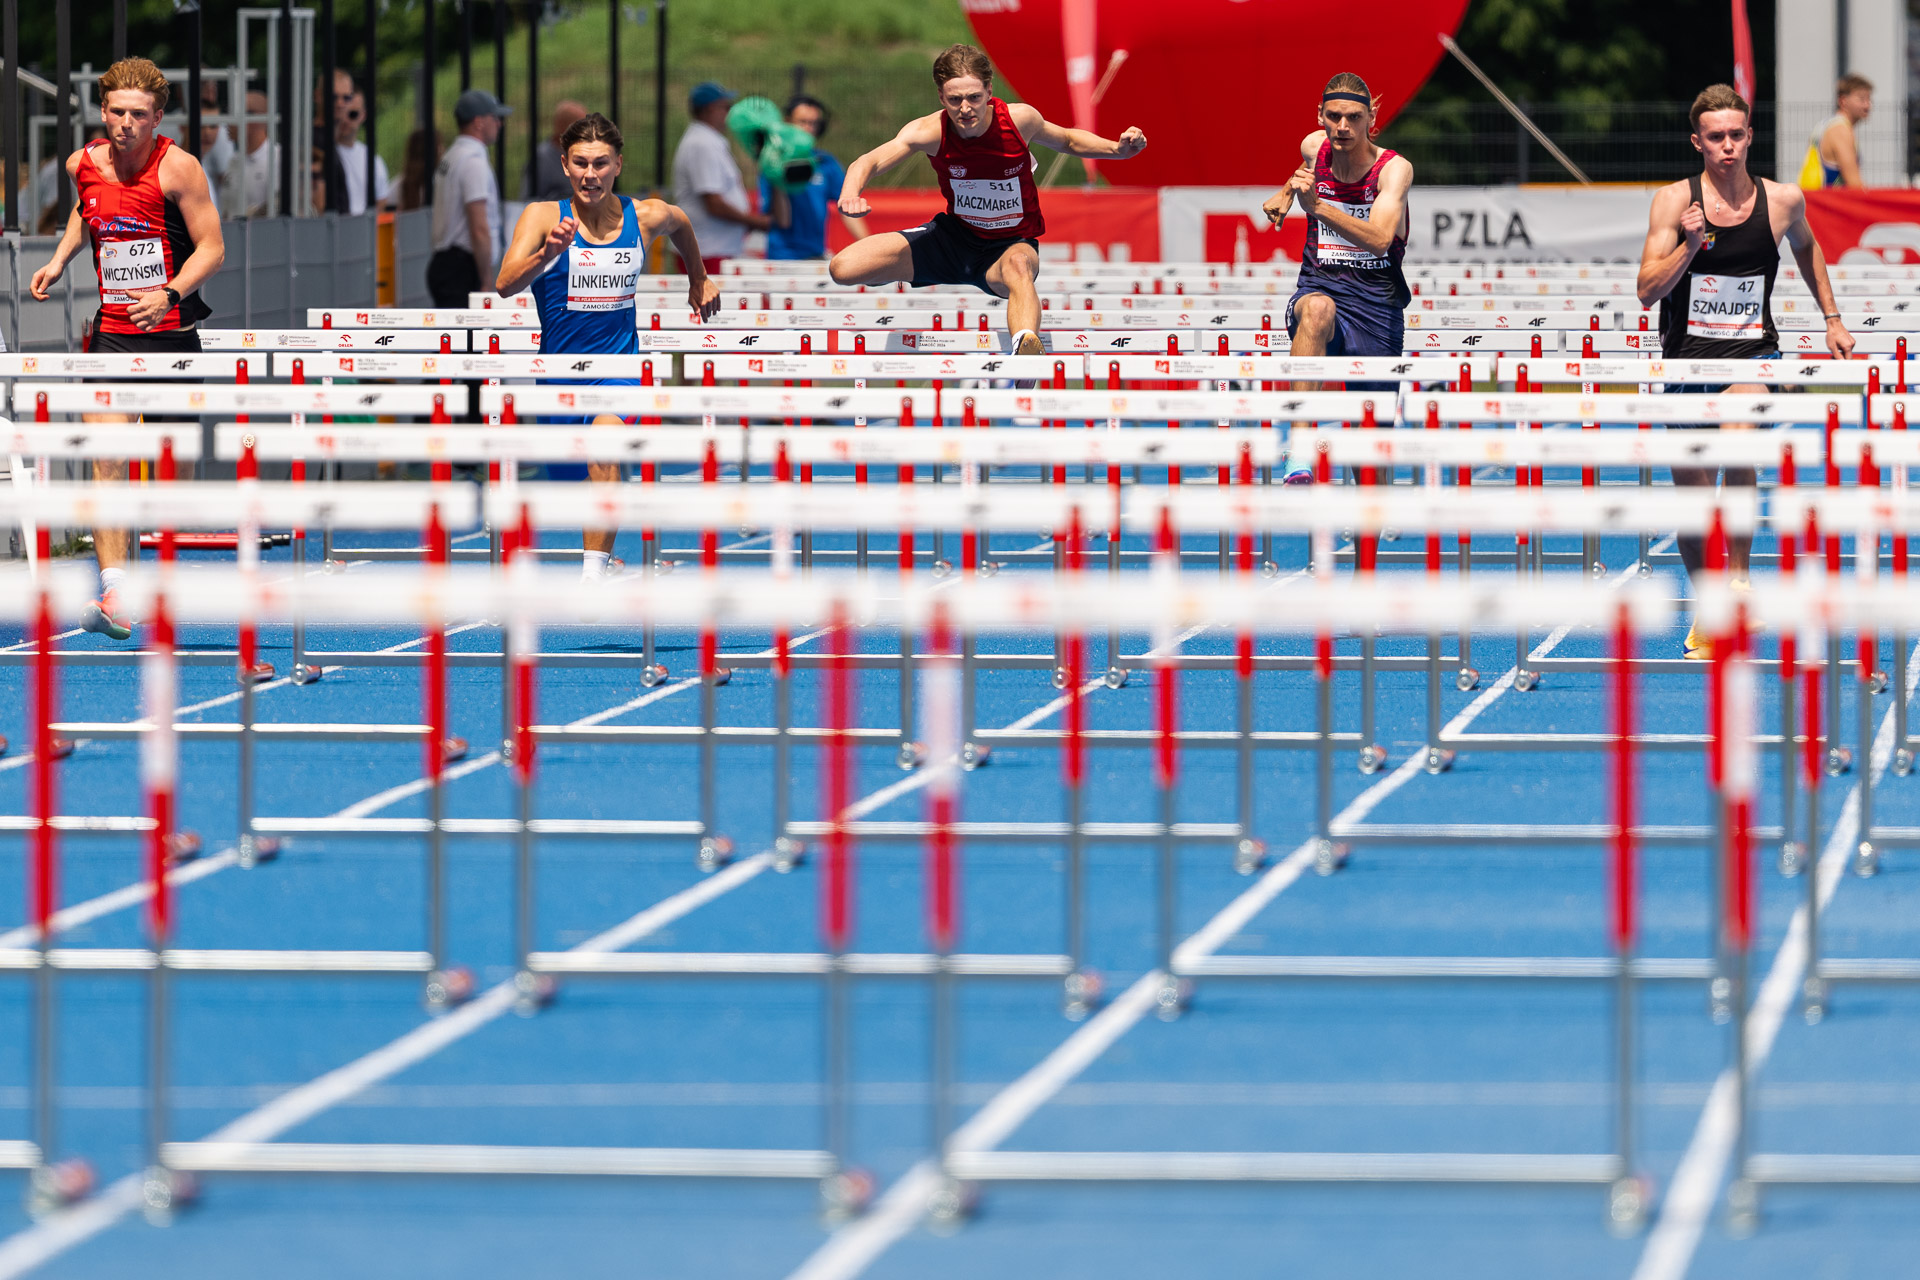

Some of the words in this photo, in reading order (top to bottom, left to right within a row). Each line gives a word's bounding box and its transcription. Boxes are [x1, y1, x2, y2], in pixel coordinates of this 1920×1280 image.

[990, 182, 1014, 192] 511
[1318, 186, 1335, 196] Enea
[956, 194, 1020, 211] KACZMAREK
[1432, 209, 1533, 250] PZLA
[130, 242, 155, 256] 672
[614, 252, 630, 264] 25
[103, 264, 163, 282] WICZYŃSKI
[572, 274, 636, 288] LINKIEWICZ
[1738, 281, 1754, 292] 47
[1692, 300, 1760, 316] SZNAJDER
[1528, 318, 1547, 327] 4F
[1862, 317, 1881, 326] 4F
[375, 336, 395, 345] 4F
[739, 336, 759, 345] 4F
[1111, 338, 1131, 347] 4F
[1462, 336, 1482, 345] 4F
